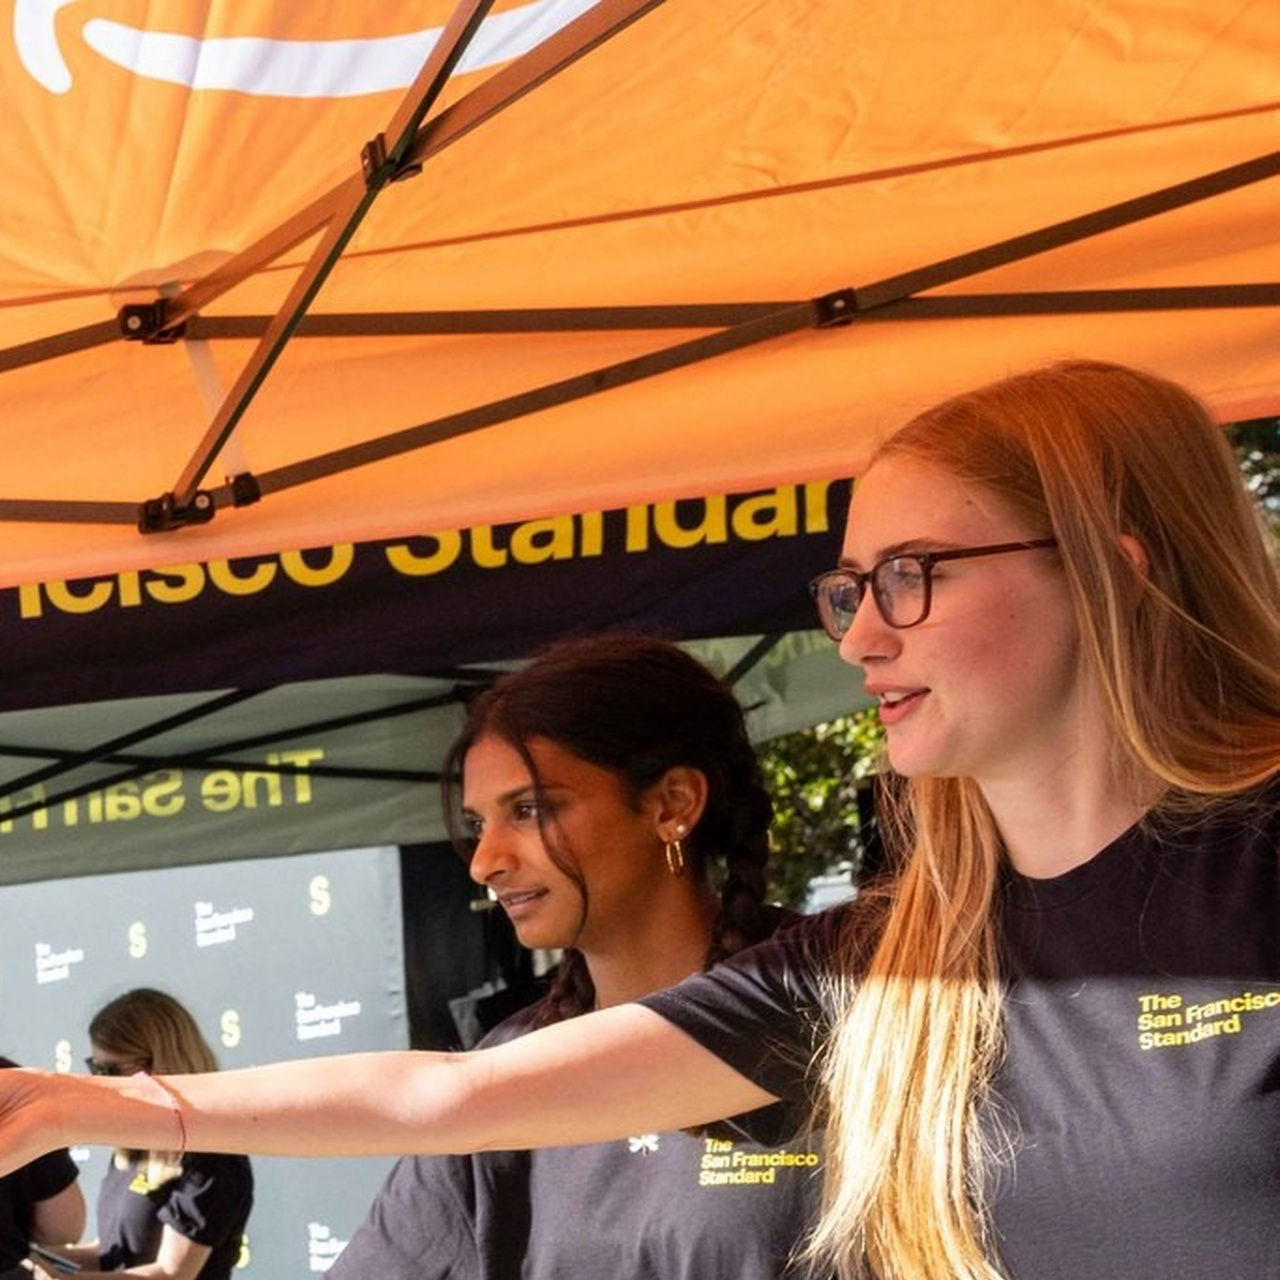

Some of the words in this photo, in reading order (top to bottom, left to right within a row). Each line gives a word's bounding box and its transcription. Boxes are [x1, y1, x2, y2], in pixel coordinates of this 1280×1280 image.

[385, 478, 856, 577] Standar
[1138, 994, 1182, 1012] The
[1138, 1012, 1182, 1031] San
[1139, 1014, 1241, 1050] Standard
[704, 1138, 733, 1153] The
[701, 1154, 730, 1169] San
[732, 1150, 819, 1167] Francisco
[698, 1168, 775, 1186] Standard
